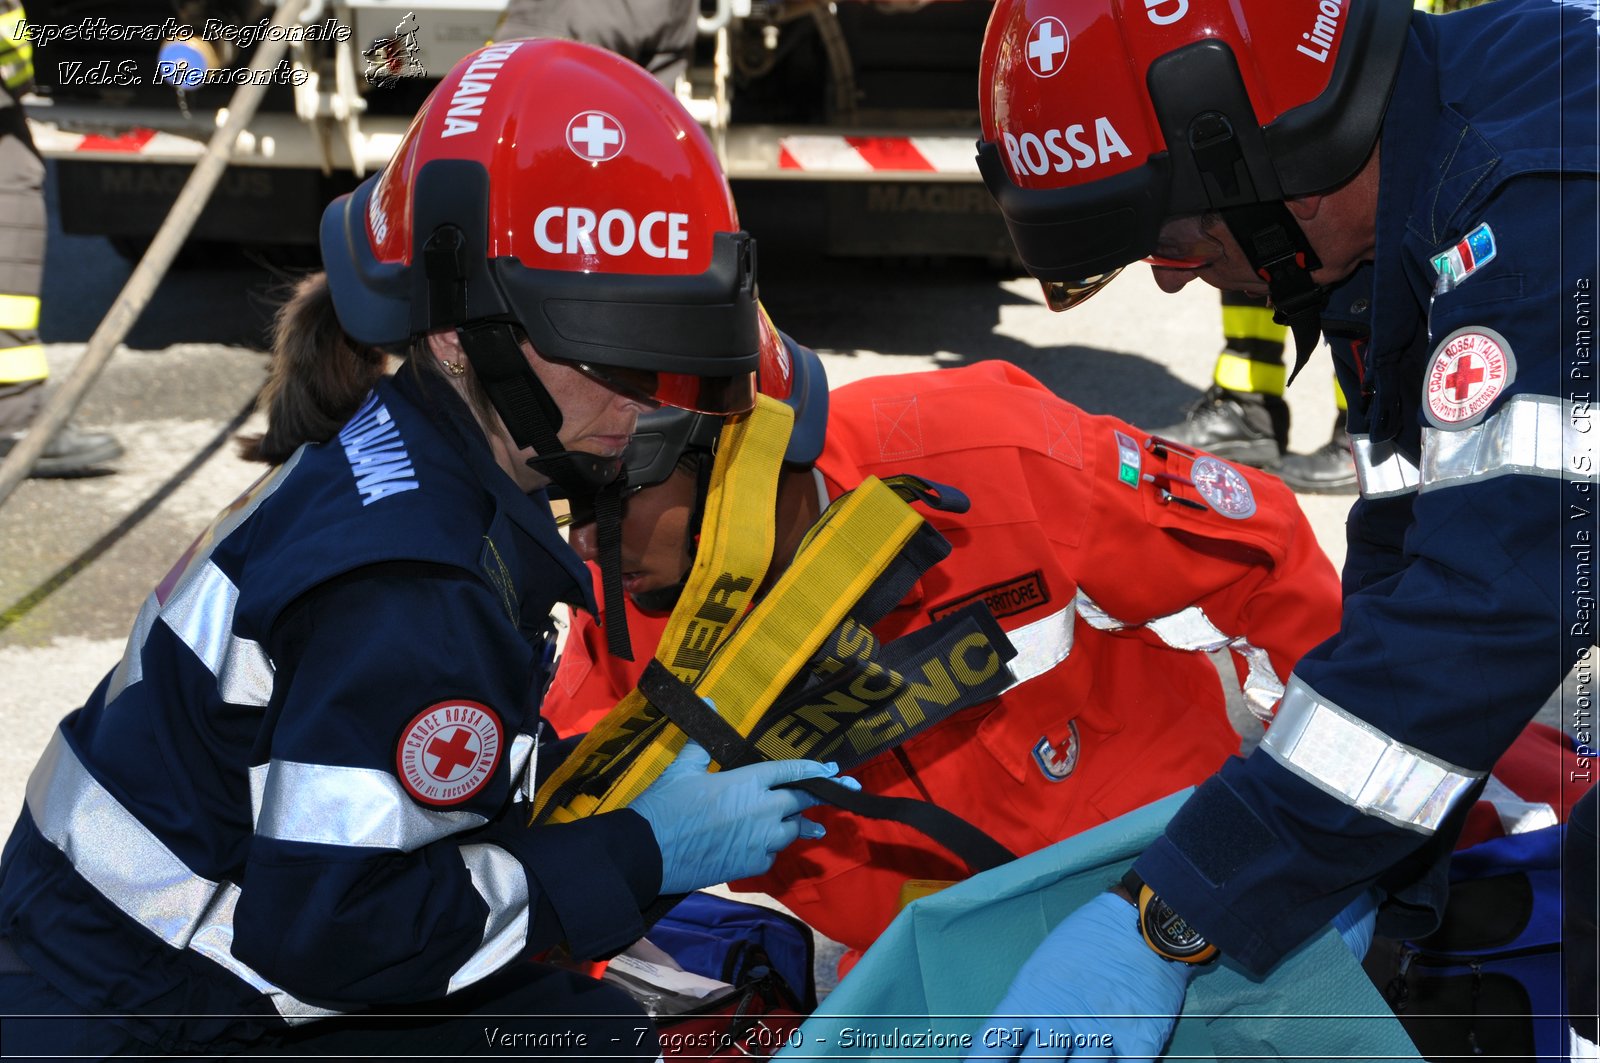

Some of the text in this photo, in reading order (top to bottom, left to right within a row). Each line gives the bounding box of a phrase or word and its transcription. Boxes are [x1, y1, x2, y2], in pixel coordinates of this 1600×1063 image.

[1003, 116, 1132, 176] ROSSA
[533, 206, 689, 260] CROCE
[1430, 337, 1502, 393] CROCE ROSSA ITALIANA
[407, 708, 496, 774] CROCE ROSSA ITALIANA
[404, 750, 480, 798] VOLONTARI DEL SOCCORSO
